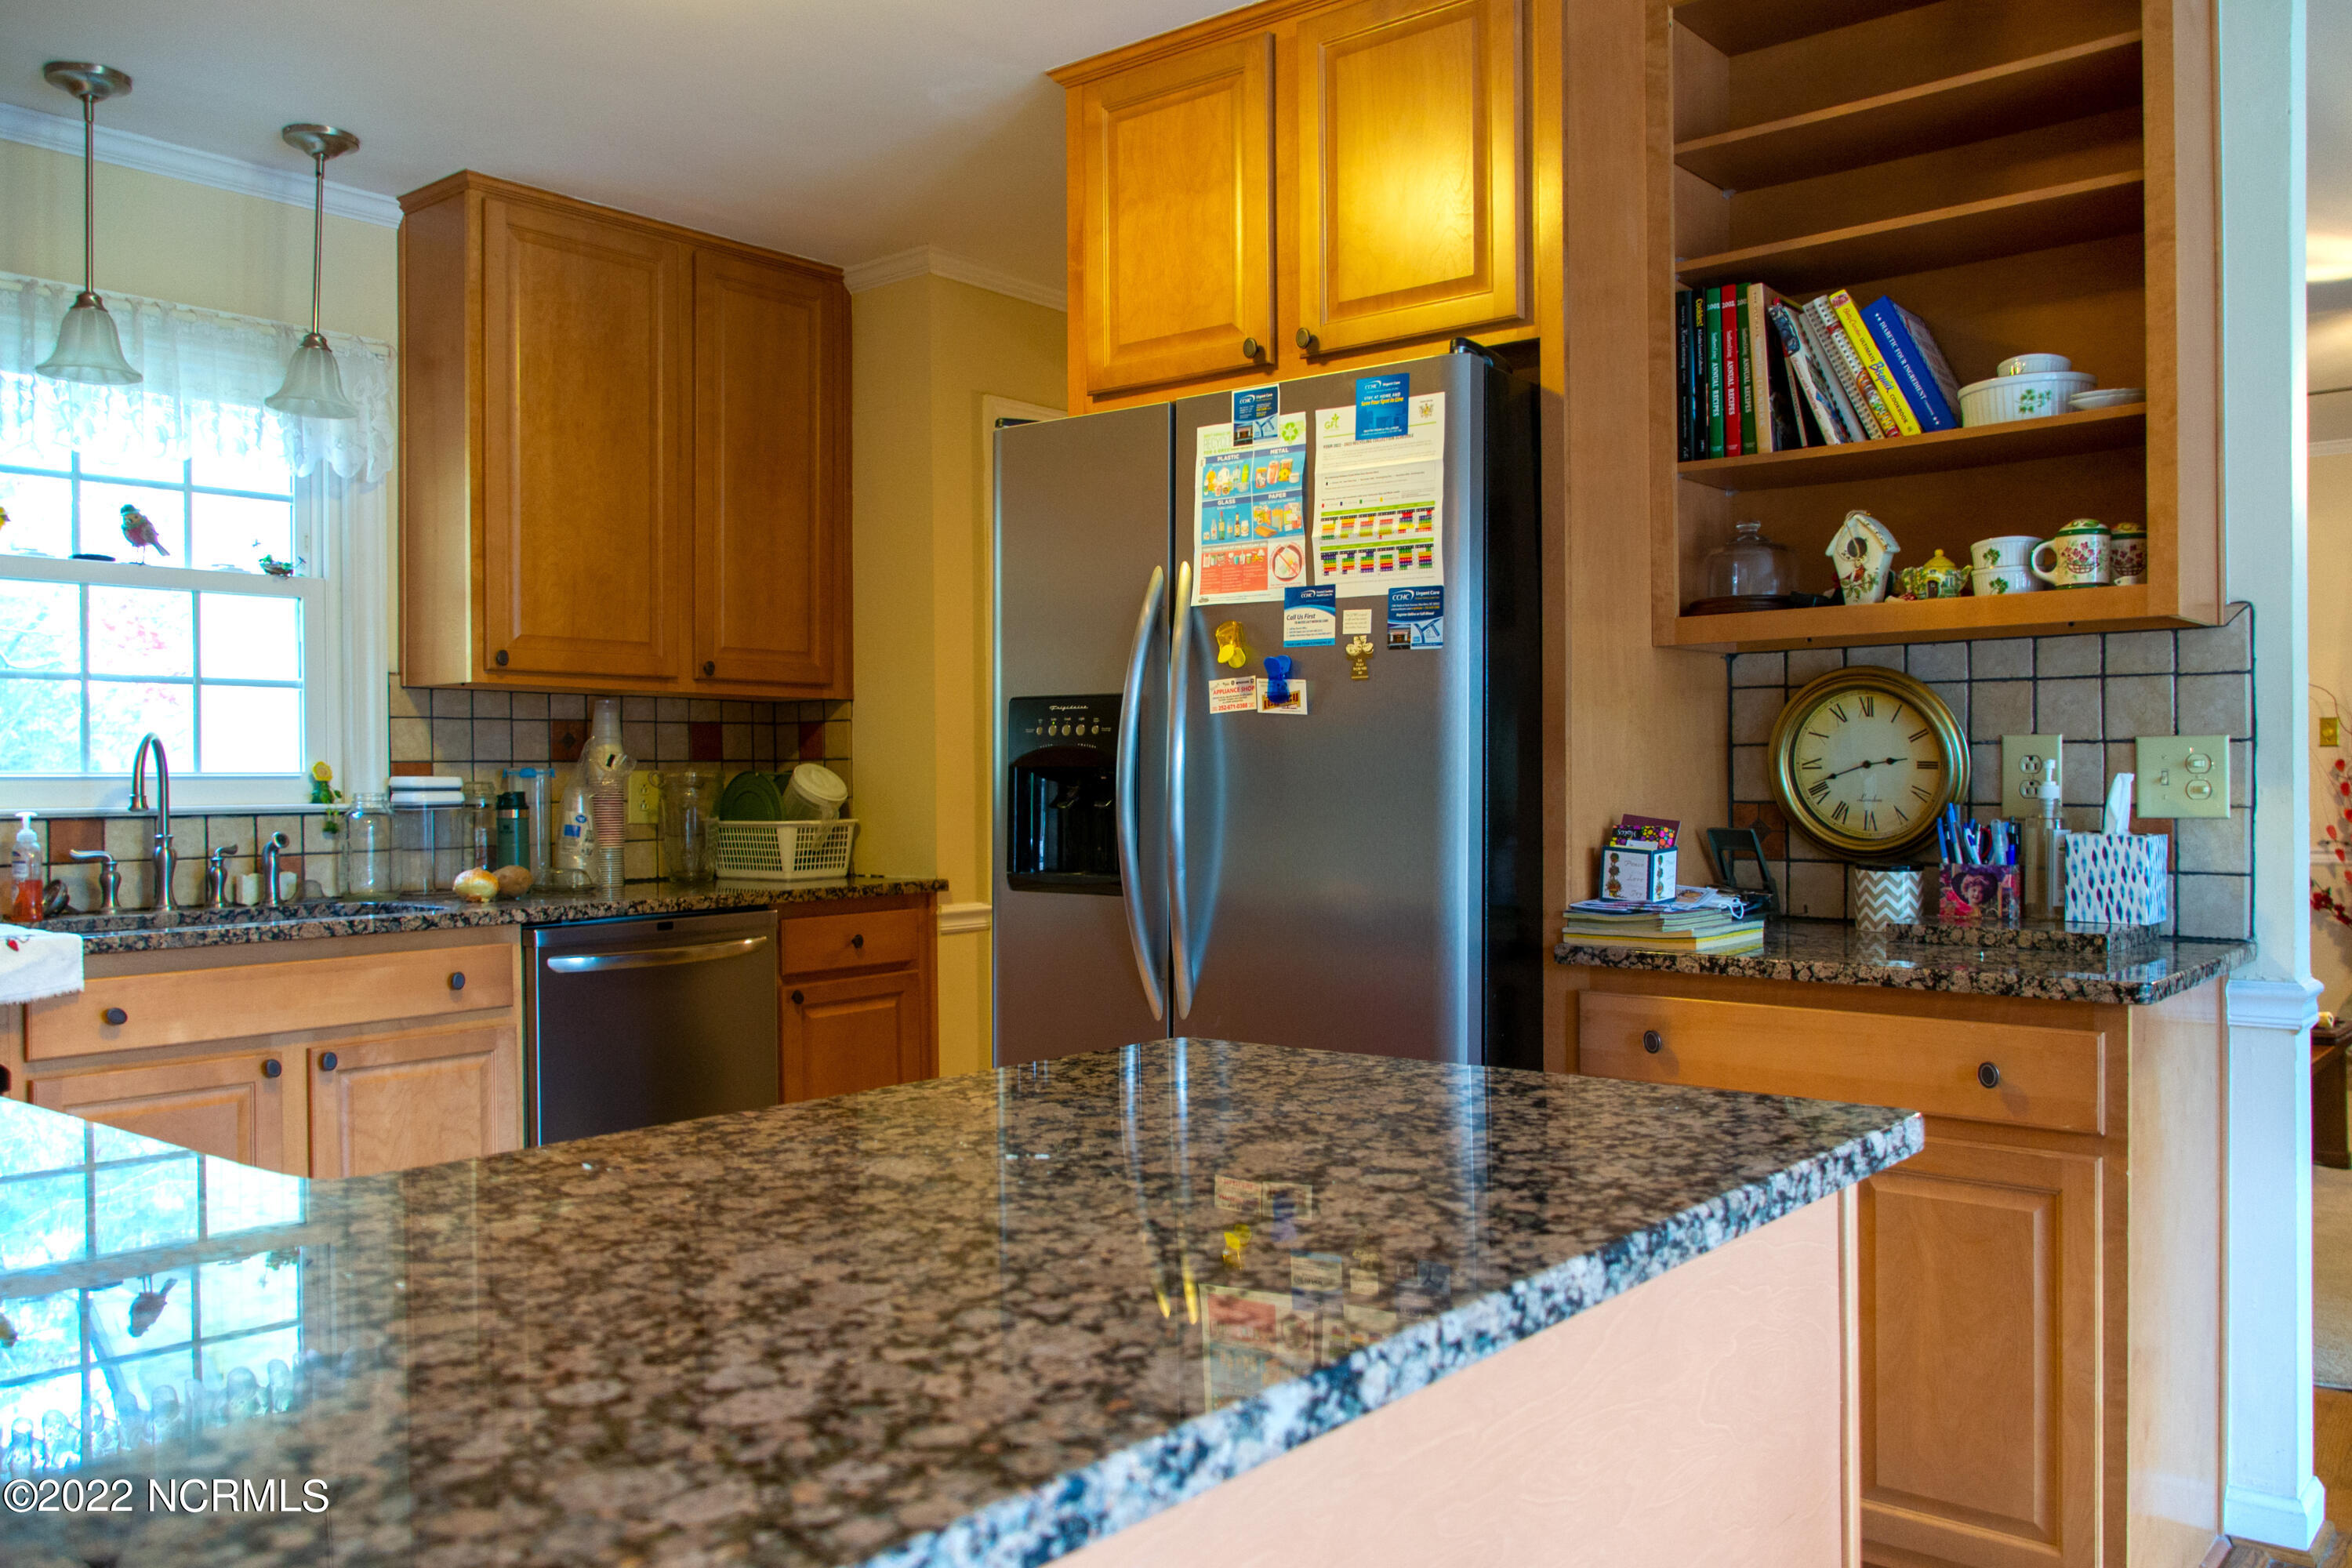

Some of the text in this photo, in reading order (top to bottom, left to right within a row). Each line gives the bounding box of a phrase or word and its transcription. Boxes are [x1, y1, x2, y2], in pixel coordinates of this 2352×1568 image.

[1879, 321, 1898, 350] DIABETIC
[1895, 347, 1907, 366] FOUR
[1904, 363, 1927, 401] INGREDIENT
[1860, 337, 1876, 362] ULTIMATE
[1869, 361, 1894, 394] Bisquick
[1889, 394, 1908, 424] COOKBOOK
[1324, 416, 1340, 430] GFL
[1213, 687, 1240, 695] APPLIANCE
[1858, 696, 1874, 718] XII
[1917, 760, 1939, 769] III
